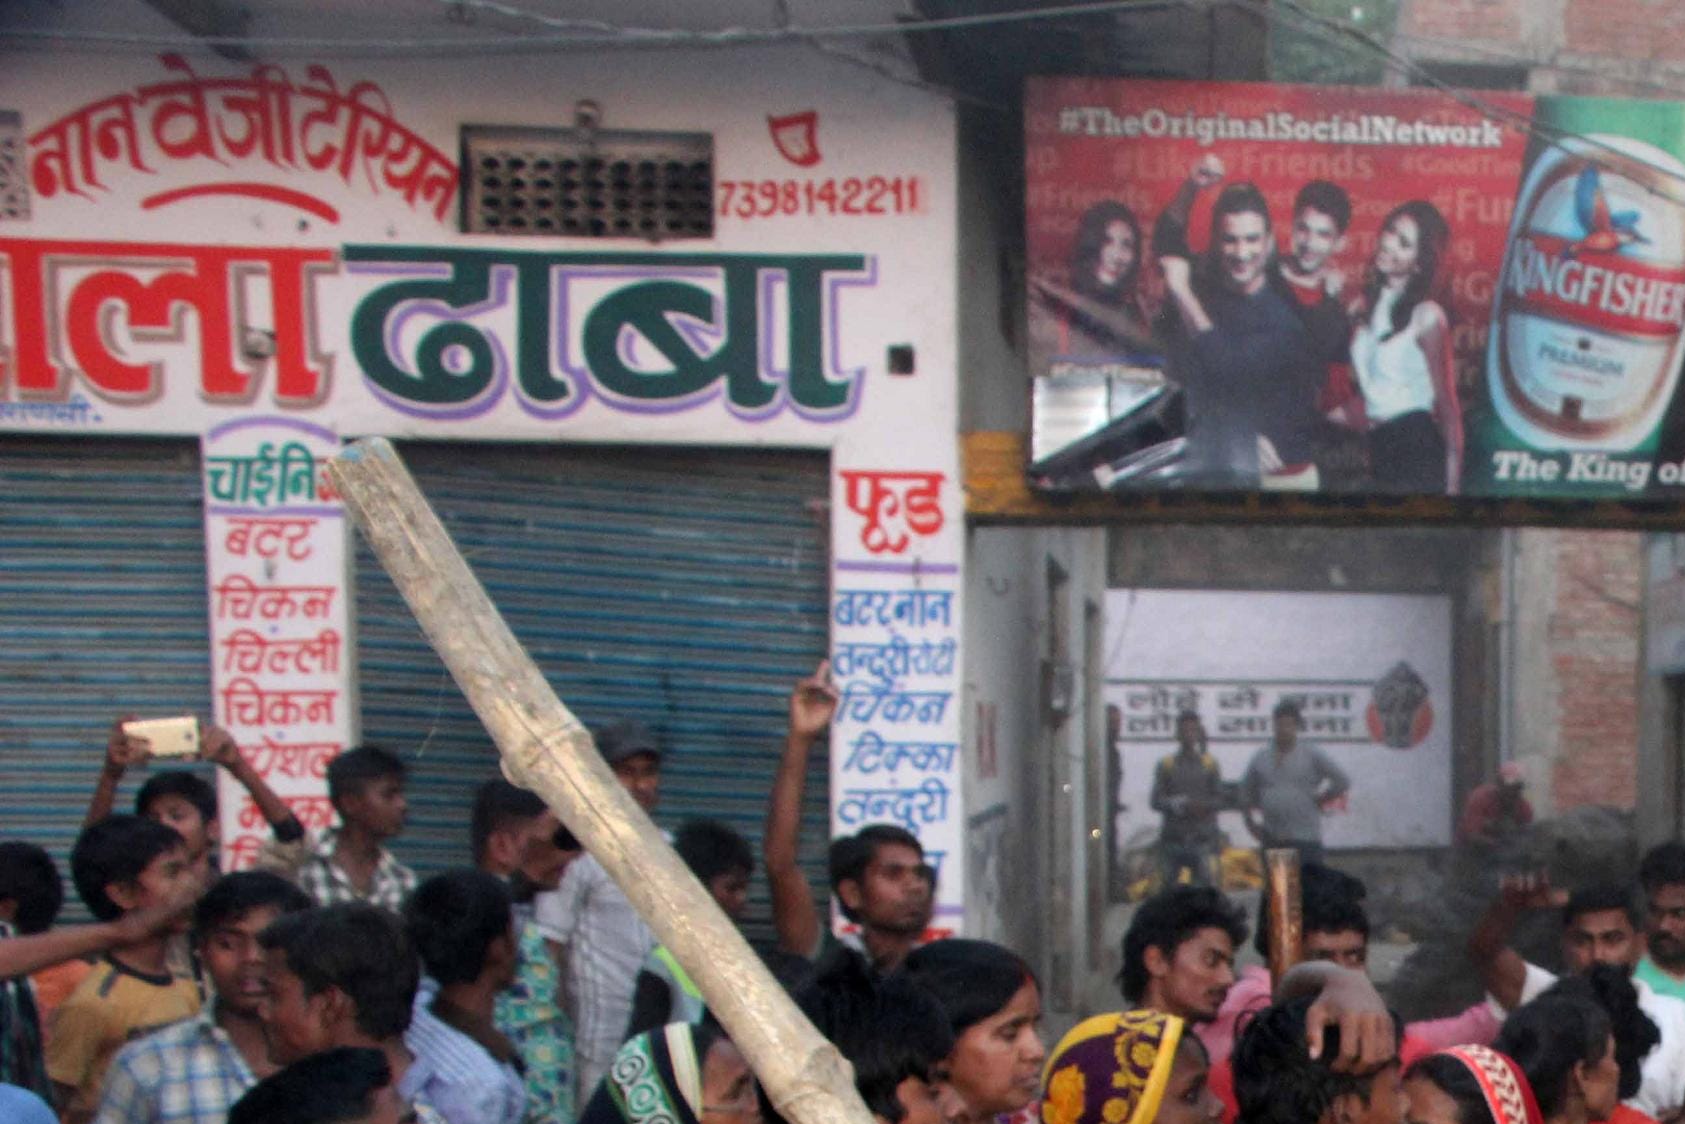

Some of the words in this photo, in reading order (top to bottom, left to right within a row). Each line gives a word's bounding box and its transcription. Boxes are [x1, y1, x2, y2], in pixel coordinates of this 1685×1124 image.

[1059, 107, 1502, 148] #TheOriginalSocialNetwork
[718, 175, 920, 219] 7398142211
[0, 238, 338, 405] ाला
[342, 244, 876, 420] ढाबा
[1493, 451, 1557, 482] The
[1566, 453, 1652, 490] King
[839, 470, 946, 554] फूड
[225, 517, 319, 561] बटर
[213, 574, 337, 620] चिकन
[221, 628, 341, 674] चिल्ली
[222, 677, 338, 726] चिकन
[836, 680, 953, 724] चिकन
